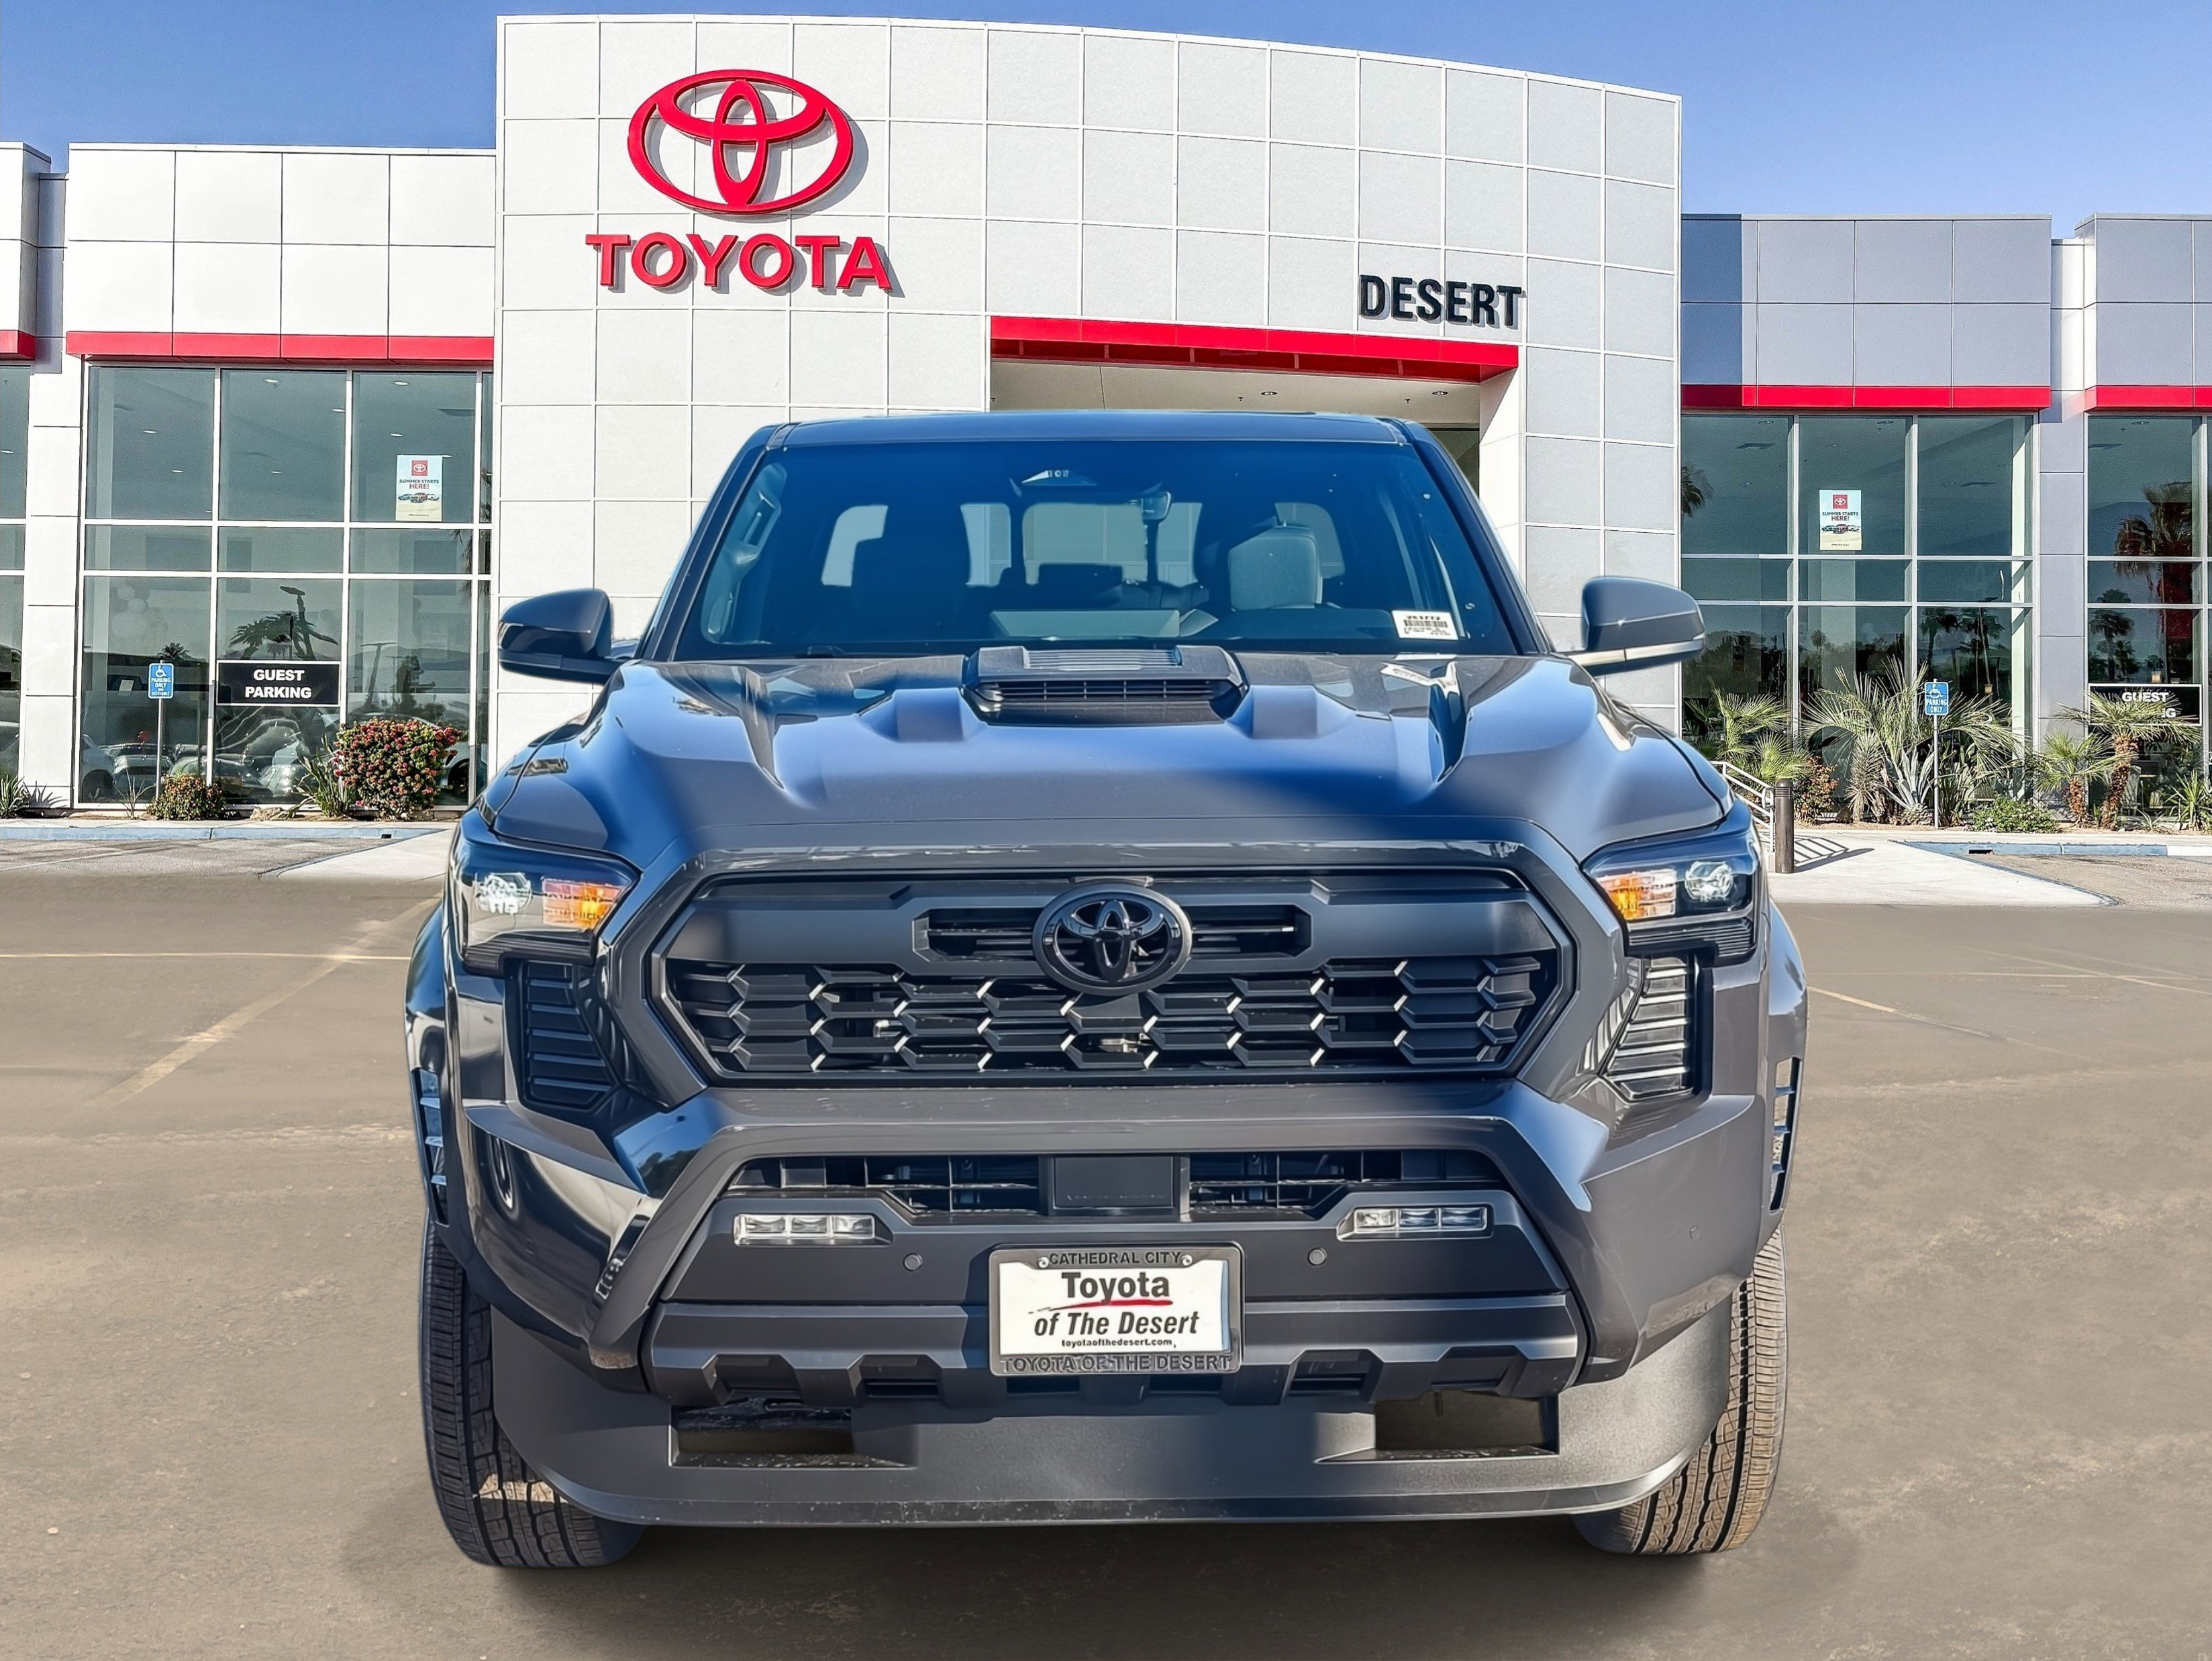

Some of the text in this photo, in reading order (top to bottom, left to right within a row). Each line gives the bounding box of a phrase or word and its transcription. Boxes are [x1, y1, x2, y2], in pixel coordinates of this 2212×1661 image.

[585, 232, 893, 291] TOYOTA
[1359, 274, 1522, 327] DESERT
[254, 669, 305, 681] GUEST
[245, 687, 311, 699] PARKING
[2121, 692, 2169, 703] GUEST
[1930, 705, 1944, 713] ONLY
[1049, 1251, 1182, 1265] CATHEDRAL CITY
[1061, 1272, 1170, 1304] Toyota
[1034, 1311, 1200, 1336] of The Desert
[1062, 1338, 1172, 1349] toyotaofthedesert.com
[1001, 1355, 1231, 1372] TOYOTA OF THE DESERT
